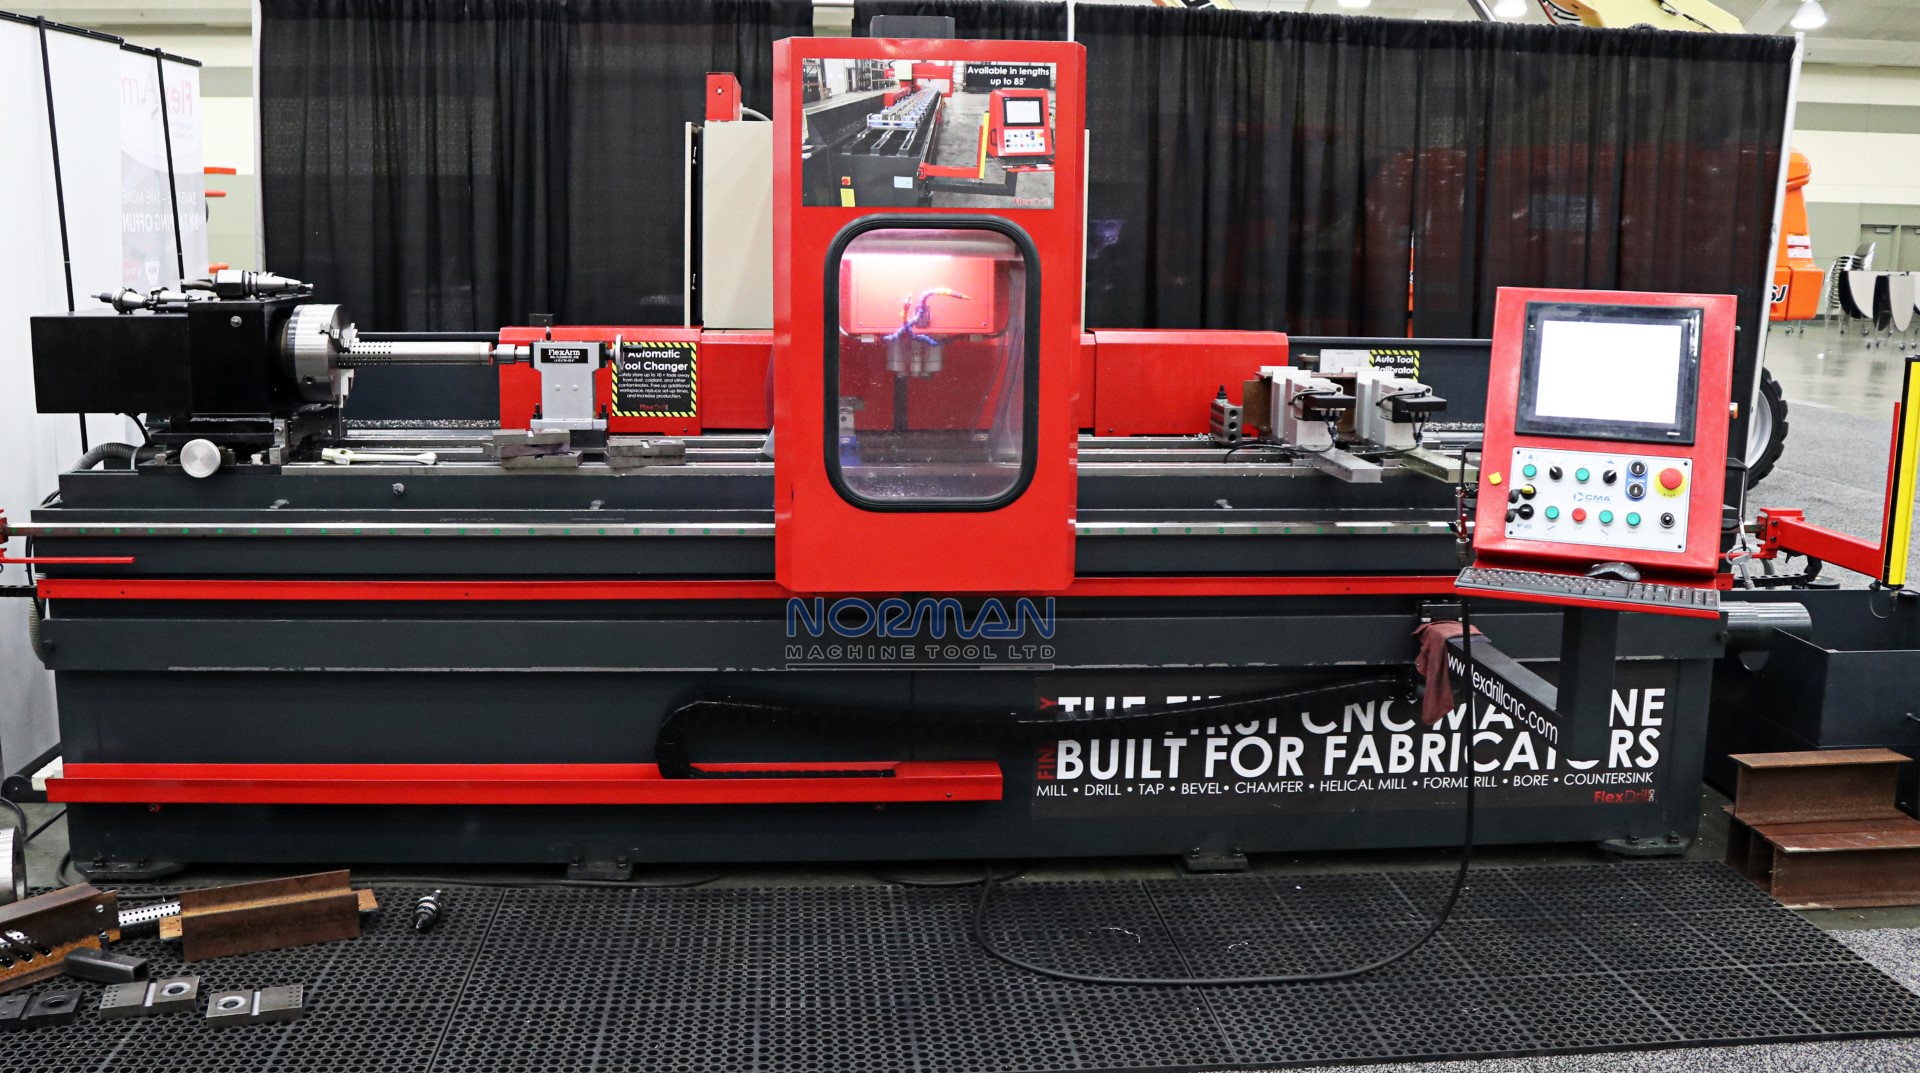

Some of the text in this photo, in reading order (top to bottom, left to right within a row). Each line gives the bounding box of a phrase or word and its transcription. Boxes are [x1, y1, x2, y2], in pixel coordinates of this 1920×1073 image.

[967, 66, 1007, 74] Available
[1019, 68, 1049, 77] lengths
[990, 78, 1001, 86] up
[1375, 355, 1414, 364] Auto Tool
[621, 361, 688, 372] ool Changer
[1585, 494, 1611, 502] CMA
[1037, 697, 1057, 780] FINY
[1057, 727, 1661, 780] BUILT FOR FABRICARS
[1036, 784, 1067, 797] MILL
[1085, 784, 1121, 796] DRILL
[1138, 783, 1165, 795] TAP
[1181, 782, 1222, 795] BEVEL
[1235, 781, 1304, 794] CHAMFER
[1320, 779, 1374, 792] HELICAL
[1378, 778, 1407, 790] MILL
[1513, 775, 1549, 787] BORE
[1564, 772, 1653, 785] COUNTERSINK
[1593, 789, 1649, 804] FlexDrill
